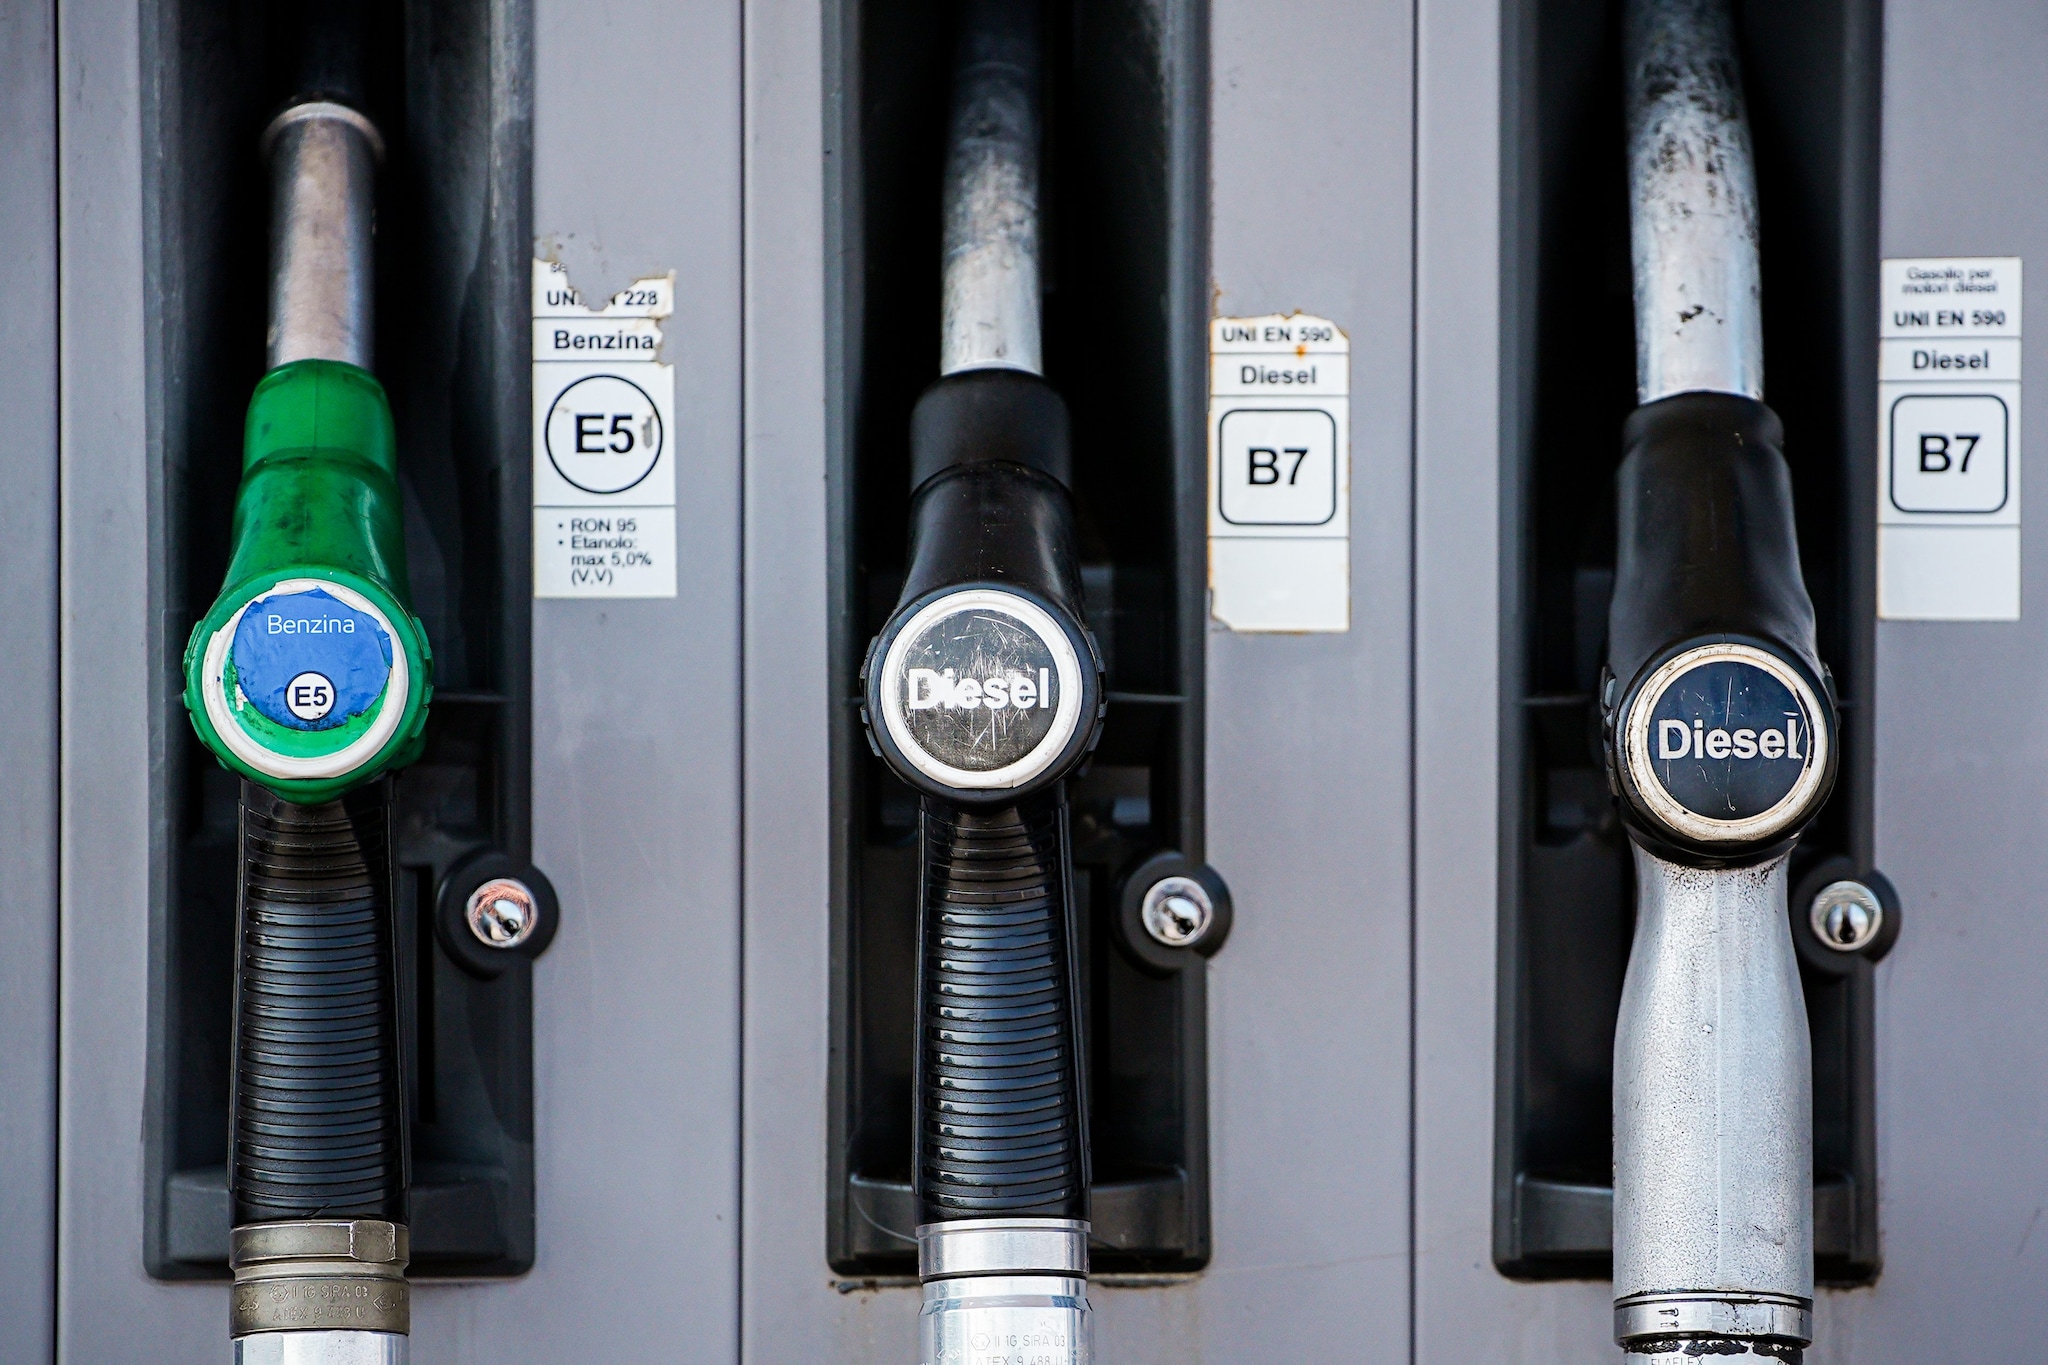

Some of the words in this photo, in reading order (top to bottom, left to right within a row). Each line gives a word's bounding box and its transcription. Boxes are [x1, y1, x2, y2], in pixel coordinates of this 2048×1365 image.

[547, 290, 579, 306] UN
[624, 290, 658, 306] 228
[1893, 310, 1930, 327] UNI
[1936, 310, 1964, 326] EN
[1972, 309, 2006, 326] 590
[554, 329, 655, 350] Benzina
[1222, 326, 1257, 342] UNI
[1264, 326, 1291, 341] EN
[1299, 326, 1333, 341] 590
[1912, 349, 1990, 370] Diesel
[1240, 364, 1318, 384] Diesel
[575, 413, 635, 454] E5
[1919, 432, 1981, 473] B7
[1247, 446, 1309, 486] B7
[571, 517, 611, 532] RON
[616, 517, 637, 532] 95
[571, 554, 605, 566] max
[266, 613, 356, 635] Benzina
[294, 685, 328, 707] E5
[908, 667, 1050, 711] Diesel
[1658, 718, 1799, 760] Diesel
[1022, 1334, 1050, 1347] SIRA
[1054, 1335, 1066, 1347] 03
